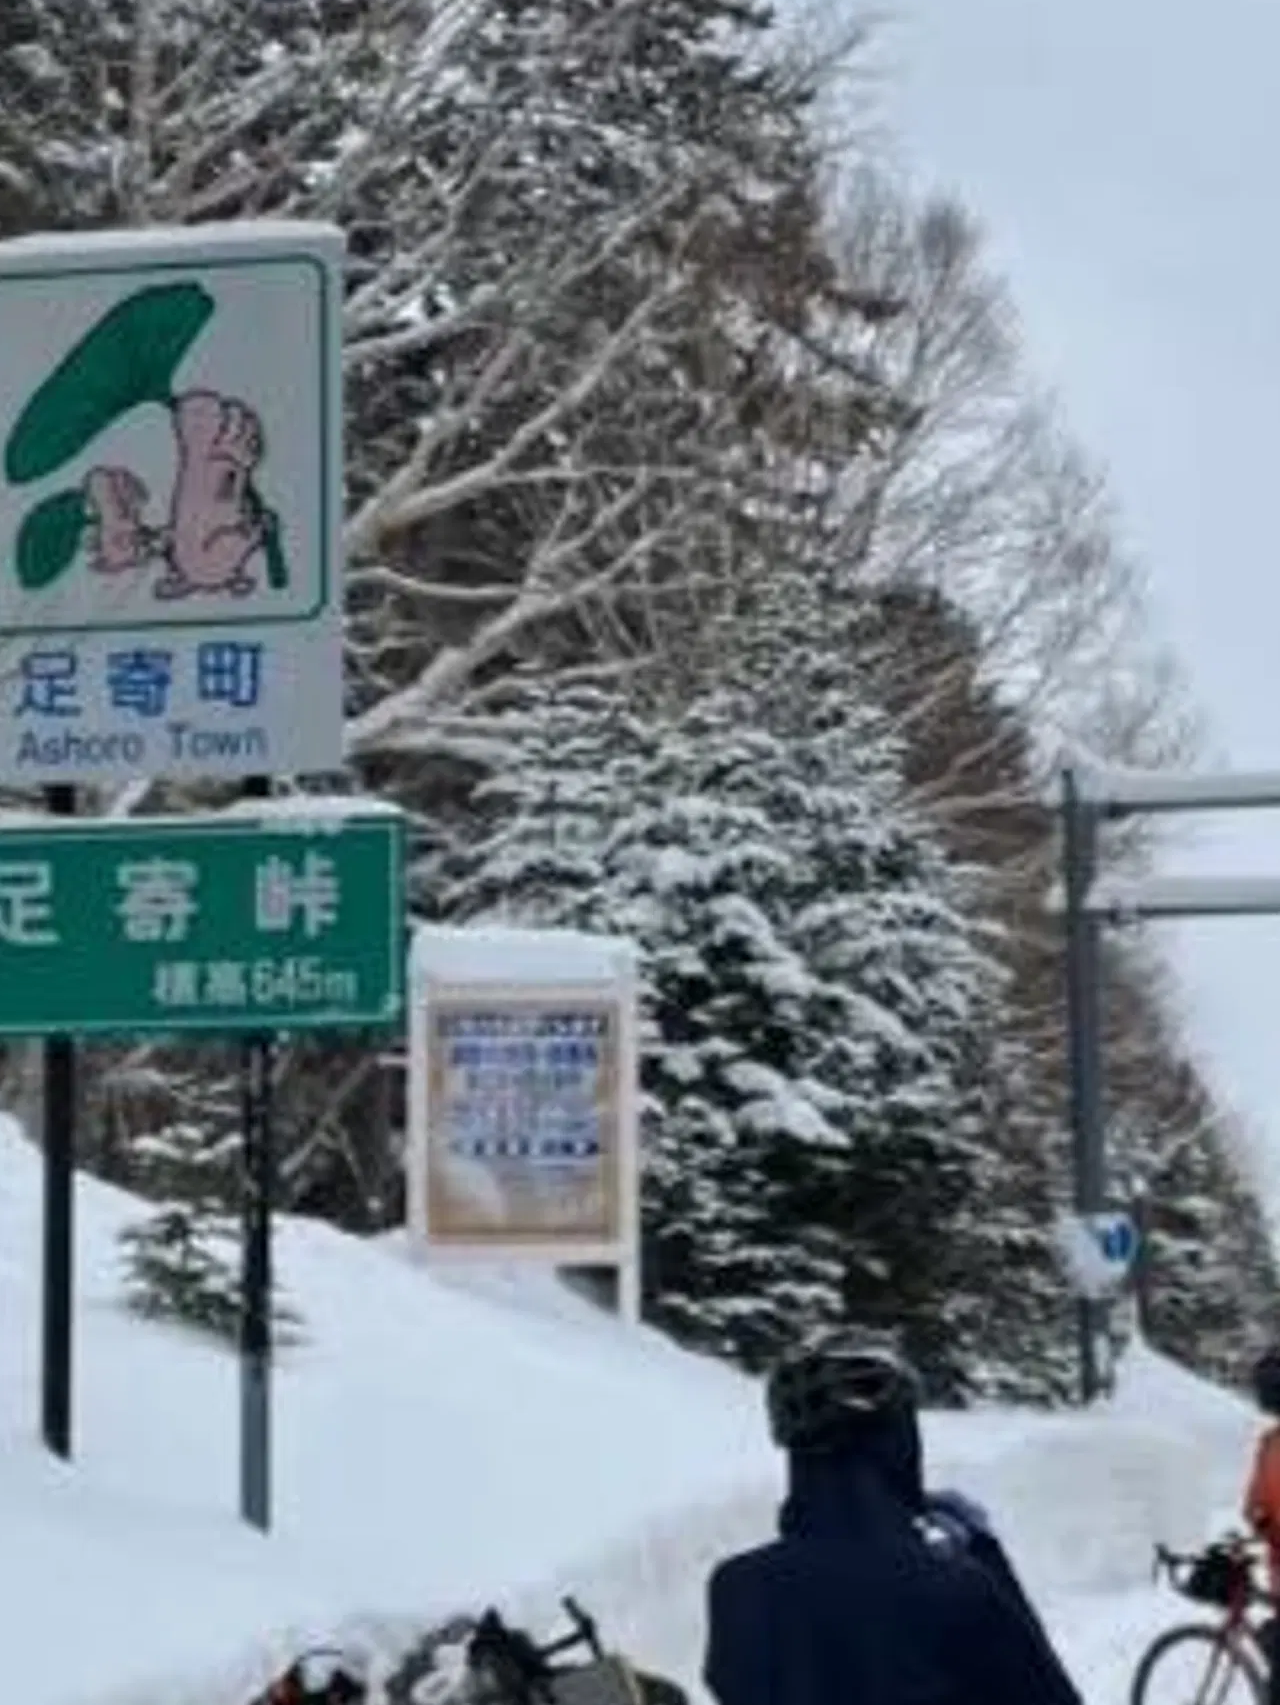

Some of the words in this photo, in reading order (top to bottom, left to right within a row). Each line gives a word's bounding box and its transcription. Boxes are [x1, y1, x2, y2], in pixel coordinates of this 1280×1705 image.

[15, 641, 263, 716] 足寄町
[17, 726, 147, 766] Ashoro
[166, 720, 267, 759] Town
